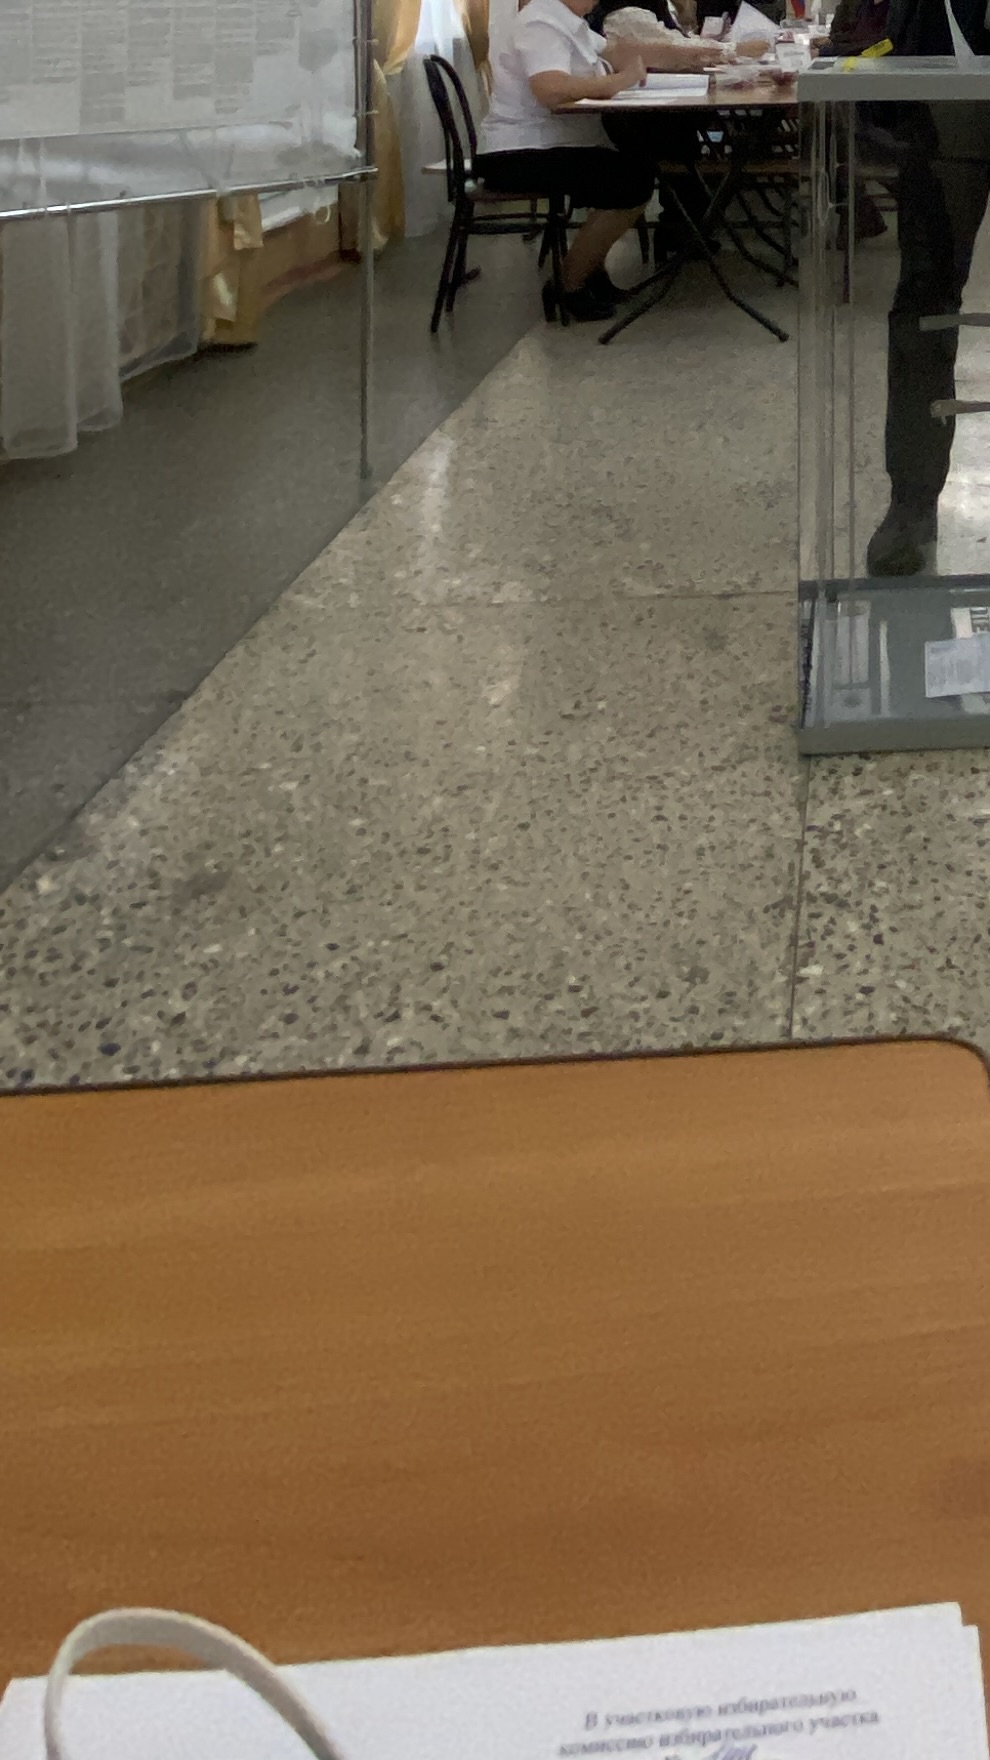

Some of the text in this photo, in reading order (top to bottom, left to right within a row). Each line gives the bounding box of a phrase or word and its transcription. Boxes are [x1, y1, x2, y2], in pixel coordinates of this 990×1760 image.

[585, 1689, 857, 1730] В участковую избирательную
[558, 1711, 879, 1757] комиссию избирательного участка
